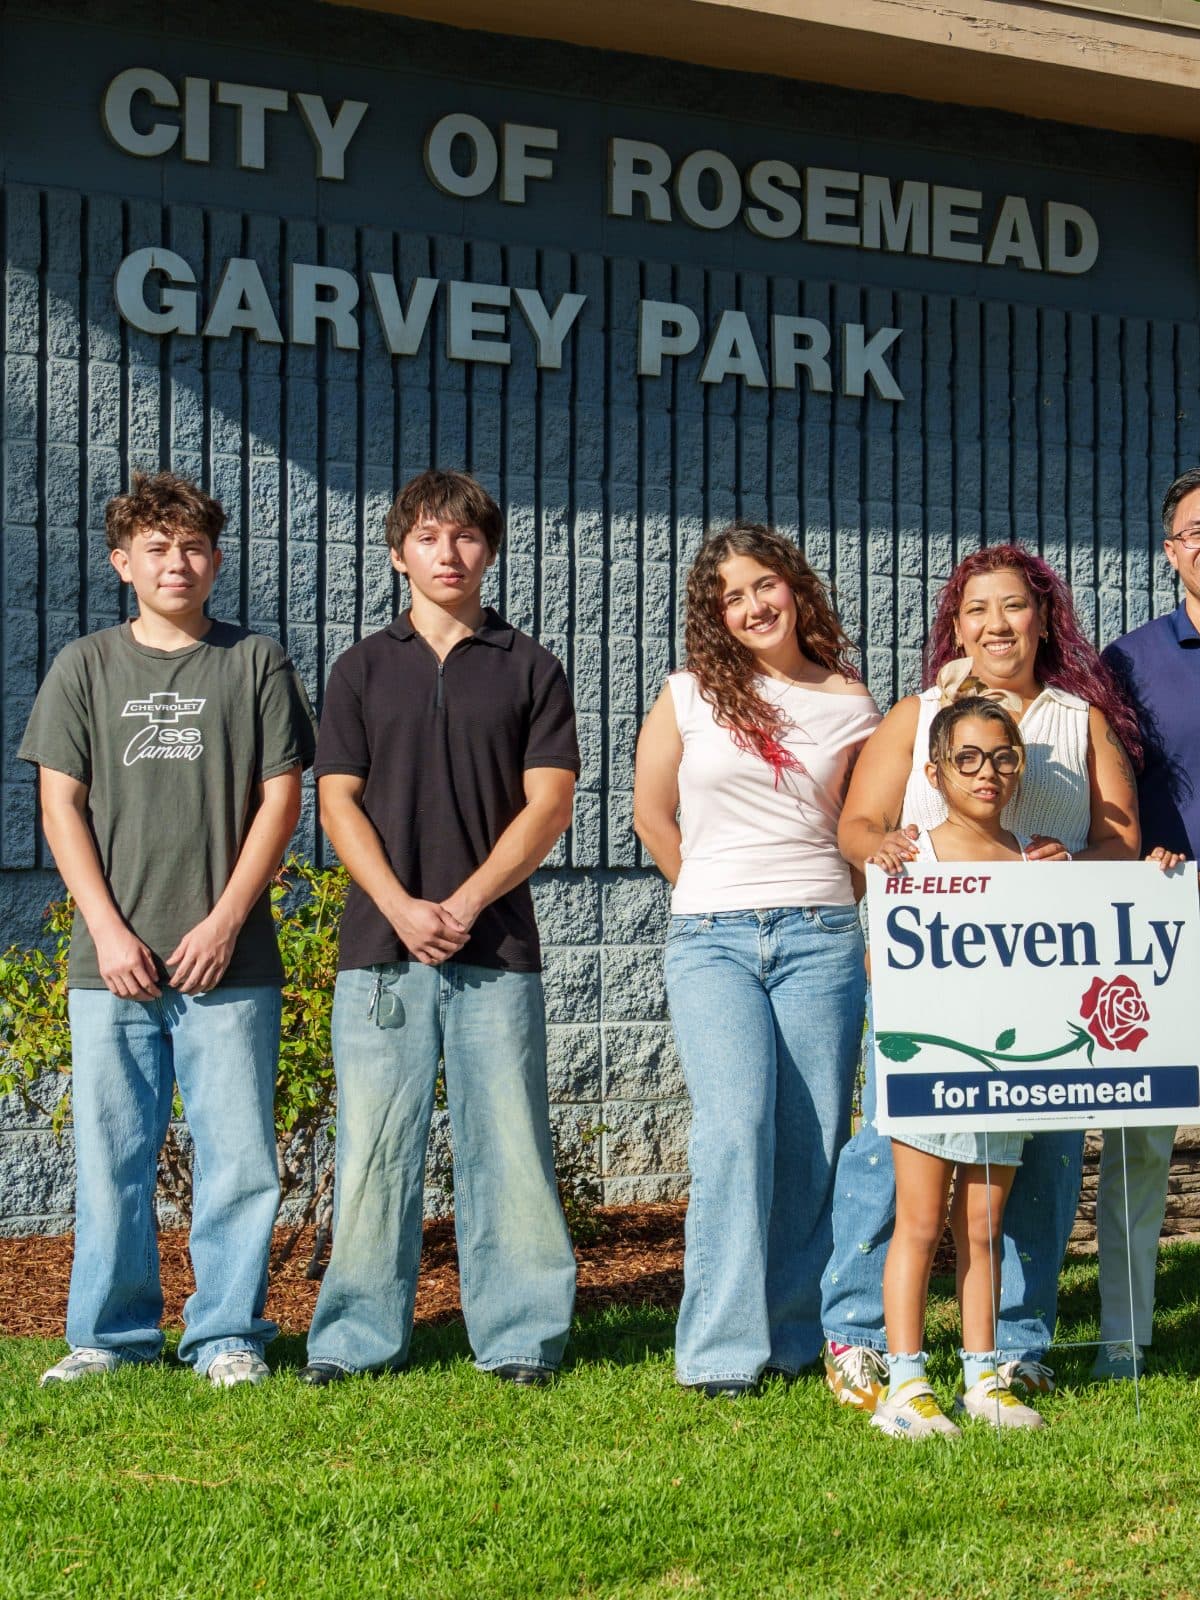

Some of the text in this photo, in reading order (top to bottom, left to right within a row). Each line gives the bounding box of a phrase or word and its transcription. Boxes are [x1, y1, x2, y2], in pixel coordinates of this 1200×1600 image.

[104, 67, 1100, 275] CITY OF ROSEMEAD
[114, 247, 905, 401] GARVEY PARK
[130, 703, 198, 712] CHEVROLET
[123, 725, 204, 766] Camaro
[159, 728, 201, 744] SS
[885, 876, 991, 895] RE-ELECT
[886, 902, 1186, 986] Steven Ly
[932, 1075, 1152, 1109] for Rosemead
